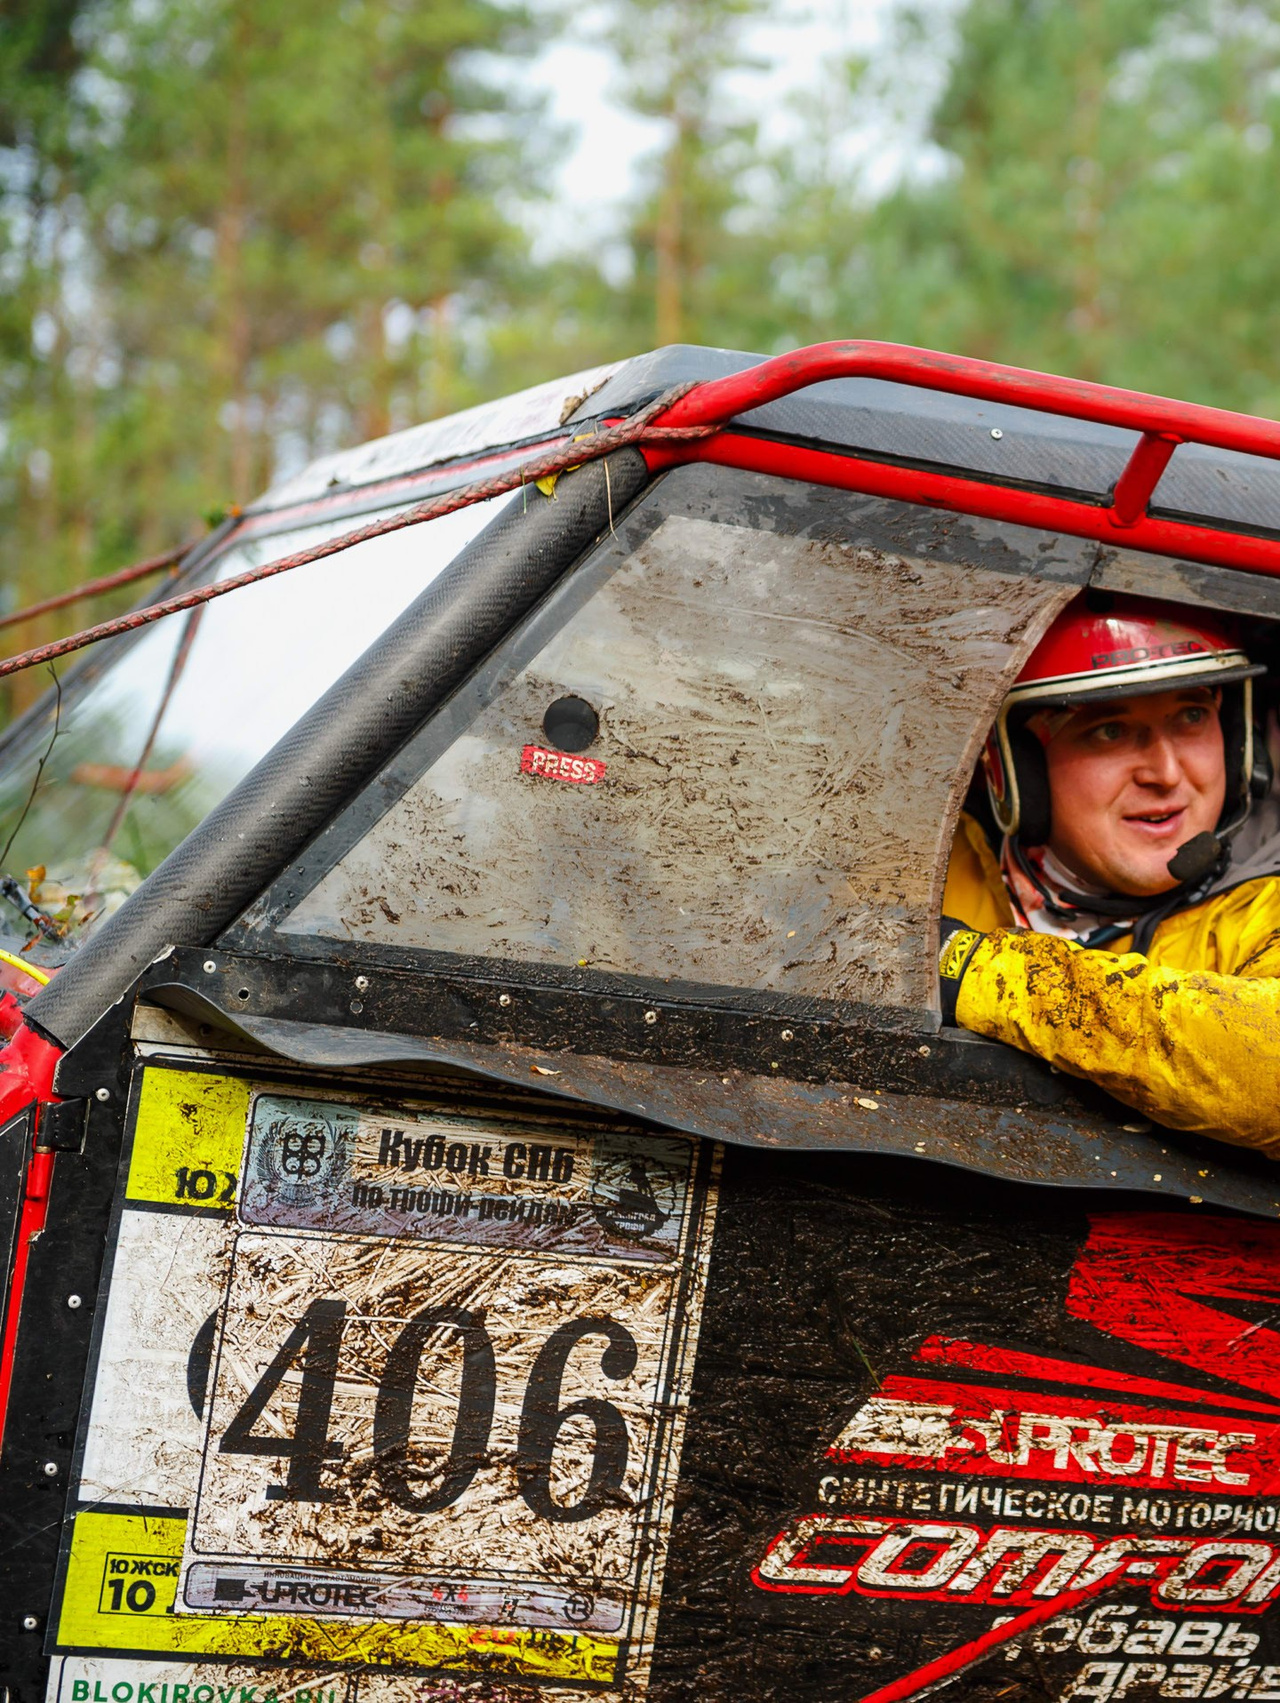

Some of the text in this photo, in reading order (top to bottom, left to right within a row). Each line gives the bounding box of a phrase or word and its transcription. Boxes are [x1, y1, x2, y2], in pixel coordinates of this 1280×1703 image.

[532, 751, 596, 782] PRESS
[376, 1129, 493, 1178] Кубок
[351, 1186, 383, 1209] по
[217, 1299, 639, 1522] 406
[108, 1578, 156, 1612] 10
[72, 1680, 335, 1703] BLOKIROVKARU
